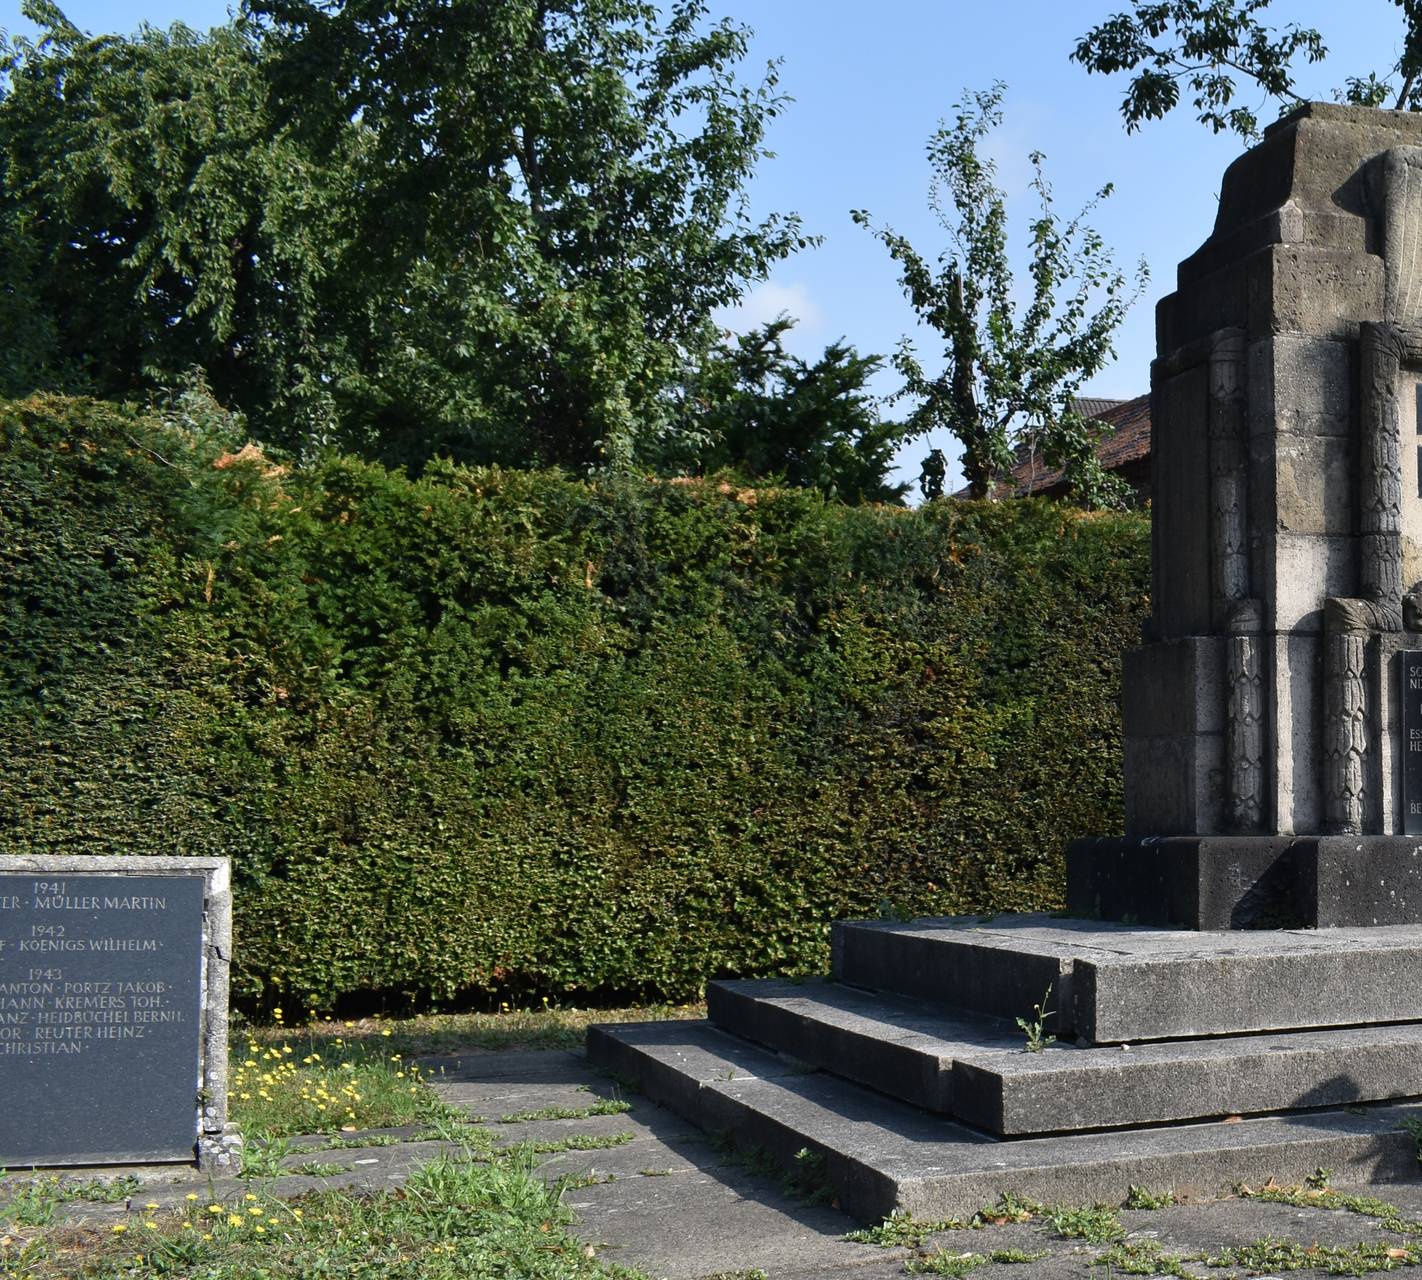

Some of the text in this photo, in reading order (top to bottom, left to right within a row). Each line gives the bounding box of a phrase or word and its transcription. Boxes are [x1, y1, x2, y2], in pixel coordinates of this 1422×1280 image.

[34, 882, 66, 894] 1941
[0, 895, 166, 910] ER MÜLLER MARTIN
[31, 925, 65, 937] 1942
[20, 939, 85, 951] KOENIGS
[89, 938, 157, 951] WILHELM
[29, 968, 62, 980] 1943
[0, 982, 165, 994] ANTON PORTZ JAKOB
[55, 997, 126, 1009] KREMERS
[130, 996, 165, 1008] JOH.
[35, 1027, 93, 1039] REUTER
[97, 1026, 145, 1038] HEINZ
